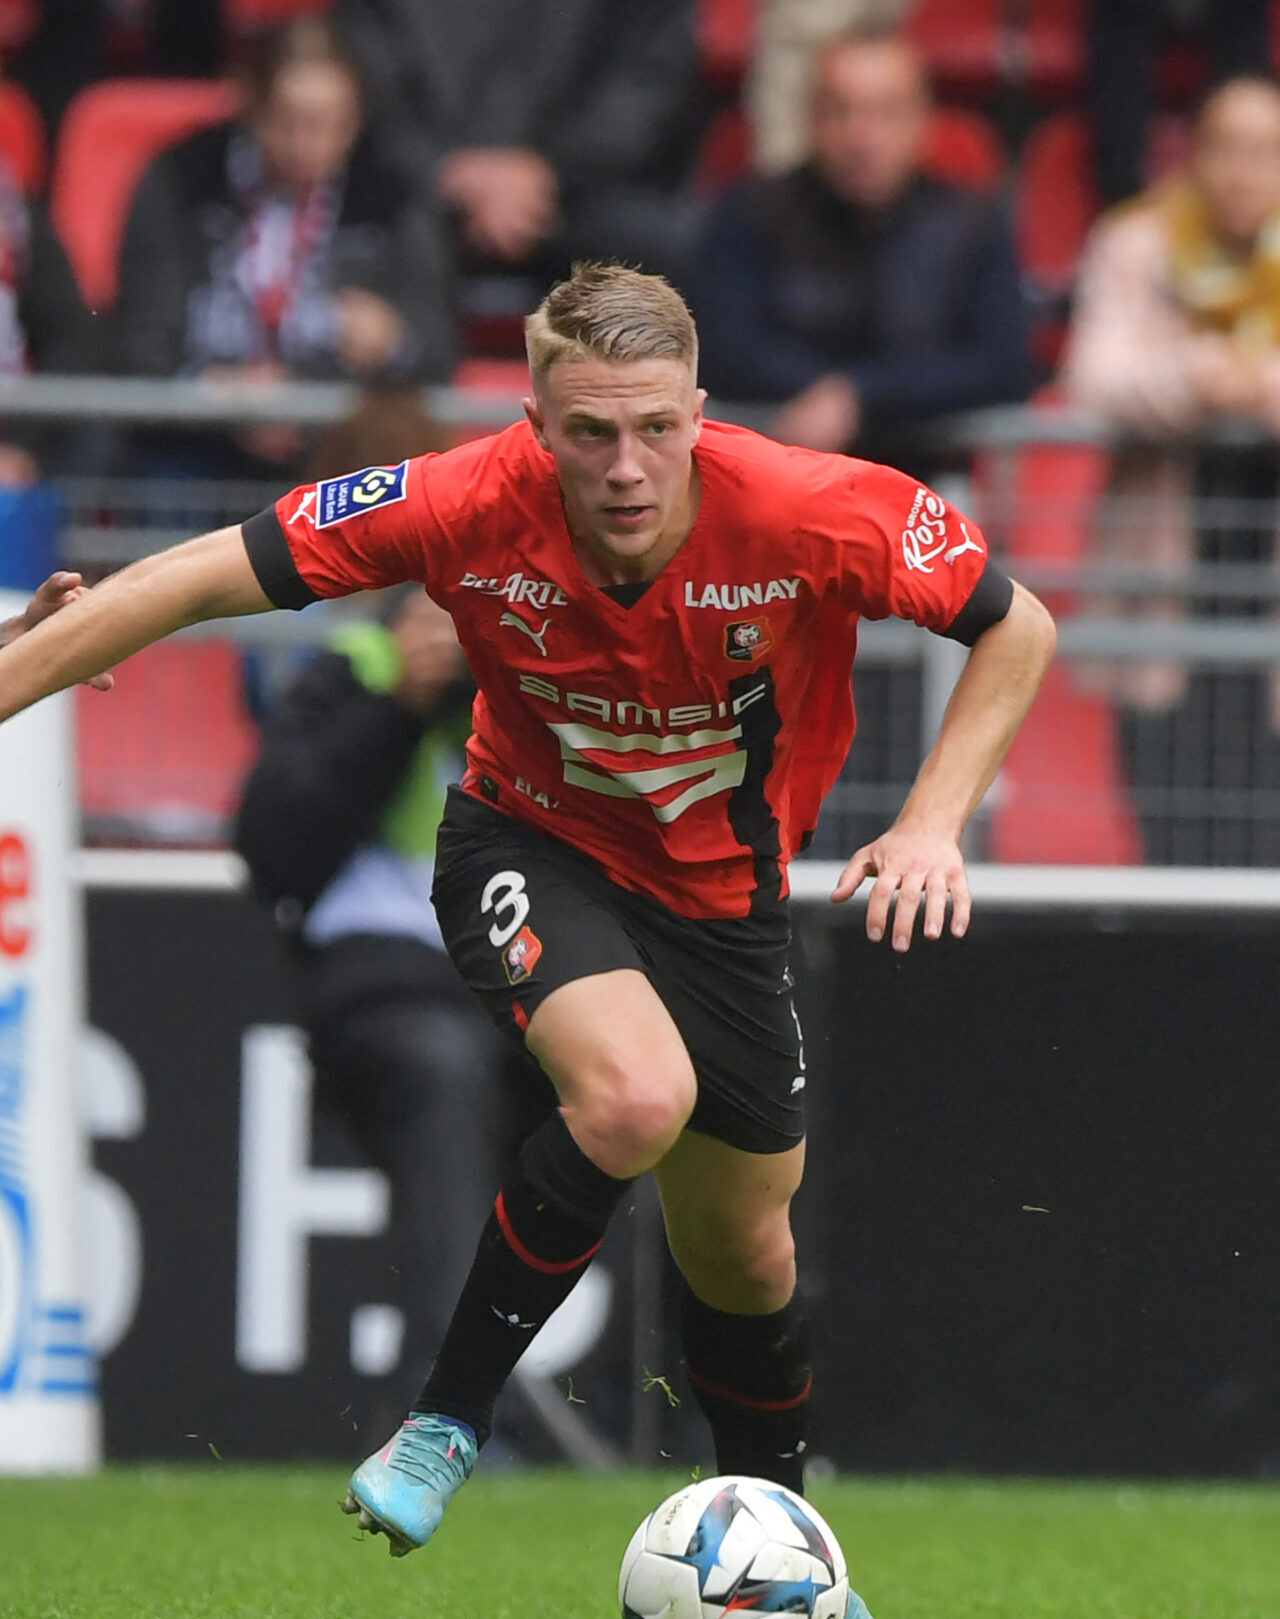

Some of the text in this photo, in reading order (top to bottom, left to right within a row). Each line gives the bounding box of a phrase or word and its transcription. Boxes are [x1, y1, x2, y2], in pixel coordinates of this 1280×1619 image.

[902, 496, 947, 574] Rose
[684, 577, 802, 611] LAUNAY
[519, 673, 767, 728] SAMSIC
[481, 870, 530, 948] 3
